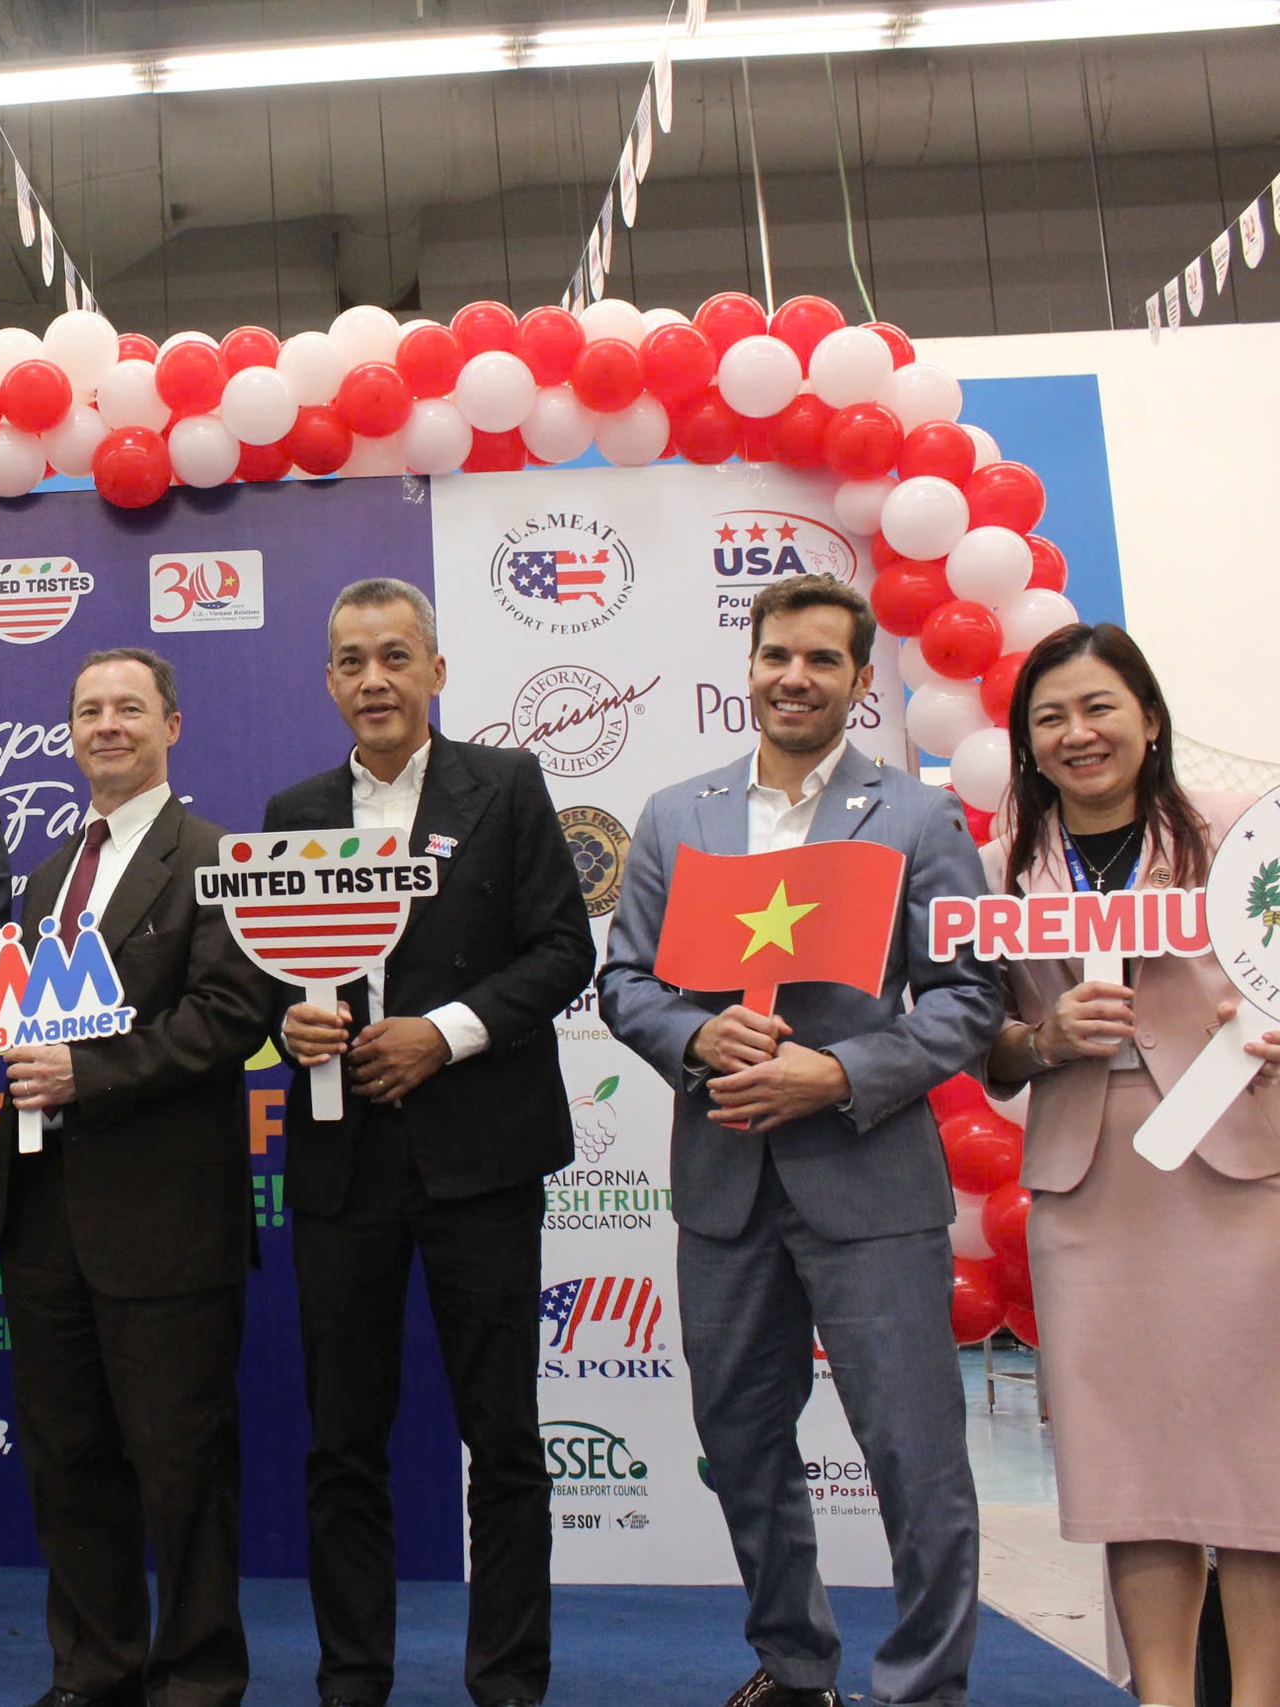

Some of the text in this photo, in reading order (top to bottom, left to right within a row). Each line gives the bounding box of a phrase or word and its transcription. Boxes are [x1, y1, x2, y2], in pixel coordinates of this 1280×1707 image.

[713, 545, 807, 577] USA
[25, 576, 90, 593] TASTES
[493, 584, 633, 635] EXPORT FEDERATION
[717, 594, 757, 608] Pou
[518, 671, 602, 727] CALIFORNIA
[537, 719, 622, 772] CALIFORNIA
[591, 813, 626, 845] FROM
[201, 865, 432, 899] UNITED TASTES
[934, 893, 1211, 955] PREMIU
[1233, 950, 1280, 1003] VIET
[543, 1170, 650, 1187] ALIFORNIA
[577, 1359, 674, 1378] PORK
[580, 1485, 611, 1496] EXPORT
[613, 1485, 648, 1496] COUNCIL
[577, 1515, 601, 1529] SOY
[831, 1506, 881, 1516] Blueberry
